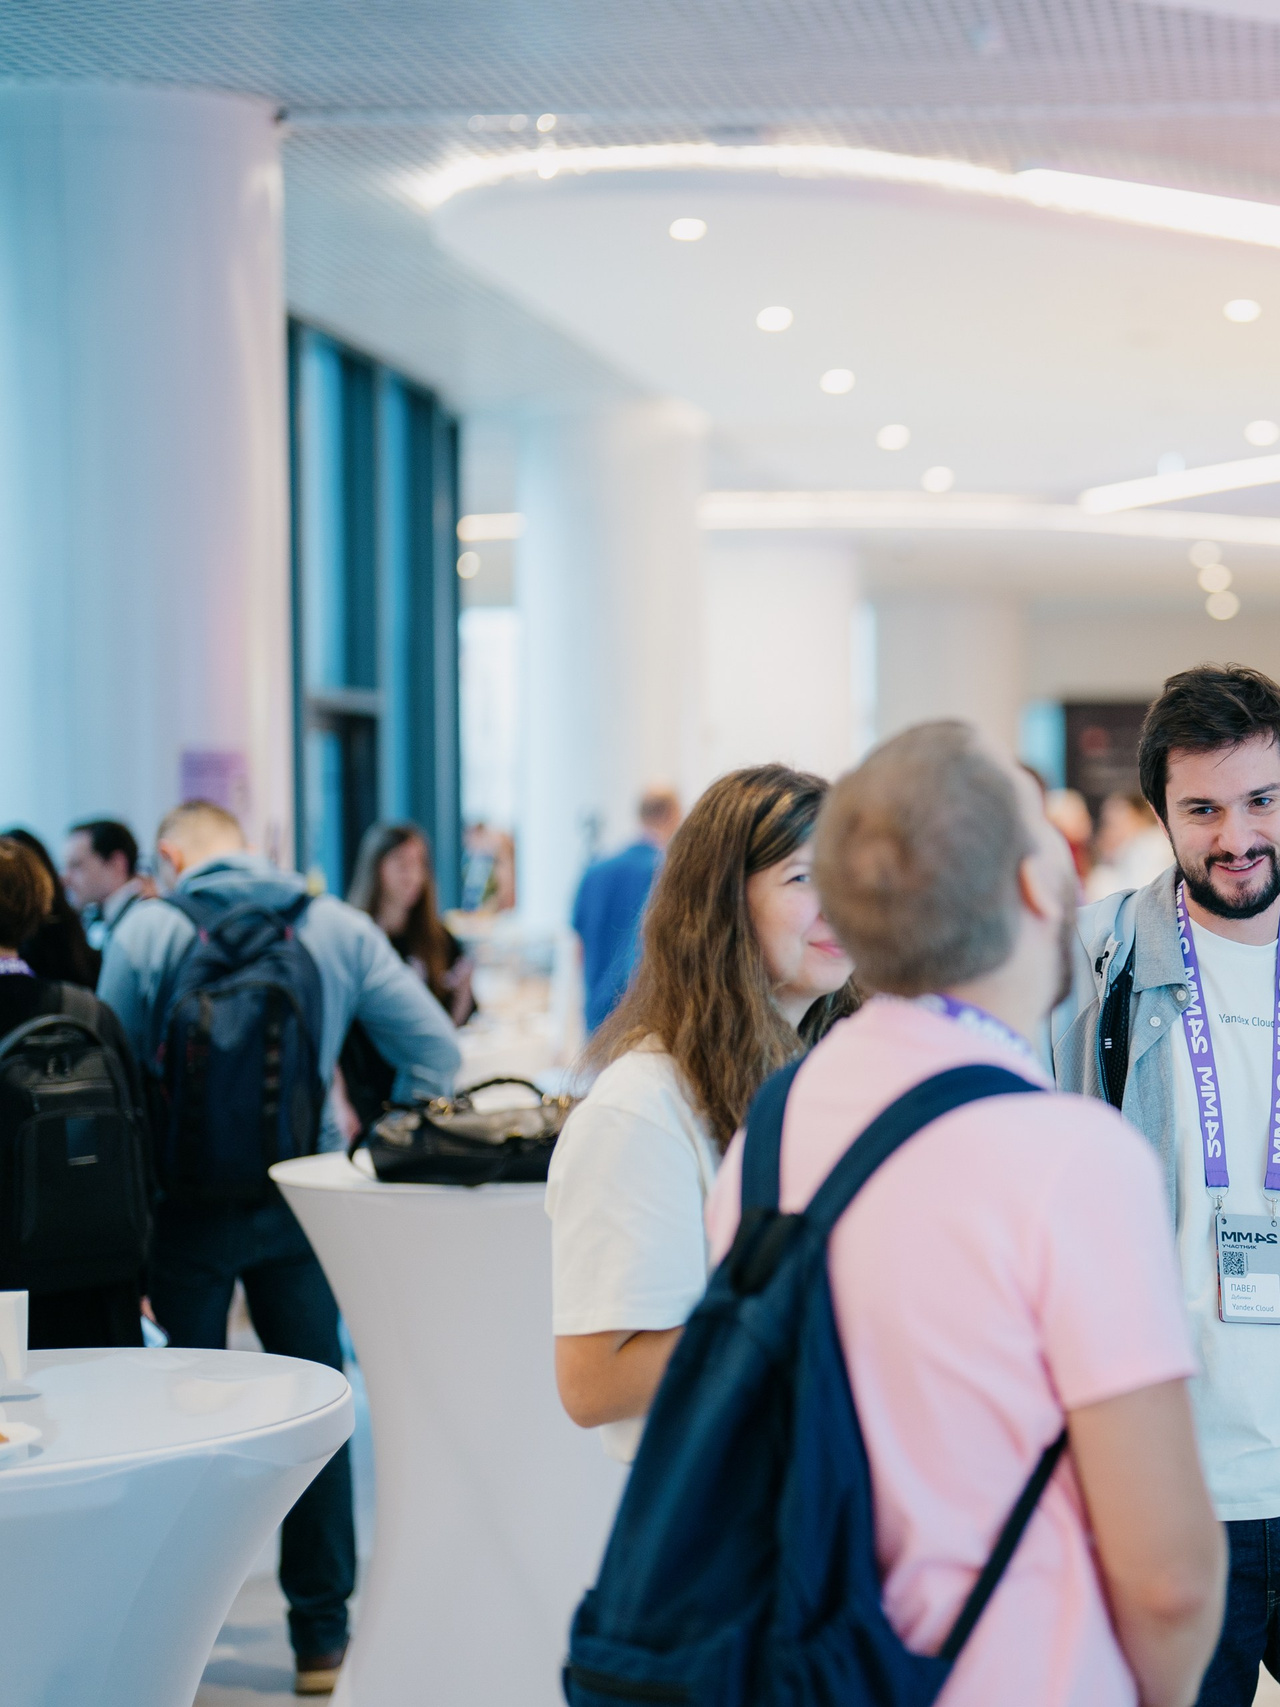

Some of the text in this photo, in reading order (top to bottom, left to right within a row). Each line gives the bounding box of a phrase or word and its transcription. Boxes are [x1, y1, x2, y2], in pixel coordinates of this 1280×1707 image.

[1218, 1013, 1250, 1026] Yandex
[1230, 1283, 1257, 1293] ПАВЕЛ
[1232, 1303, 1275, 1312] Yandex Cloud
